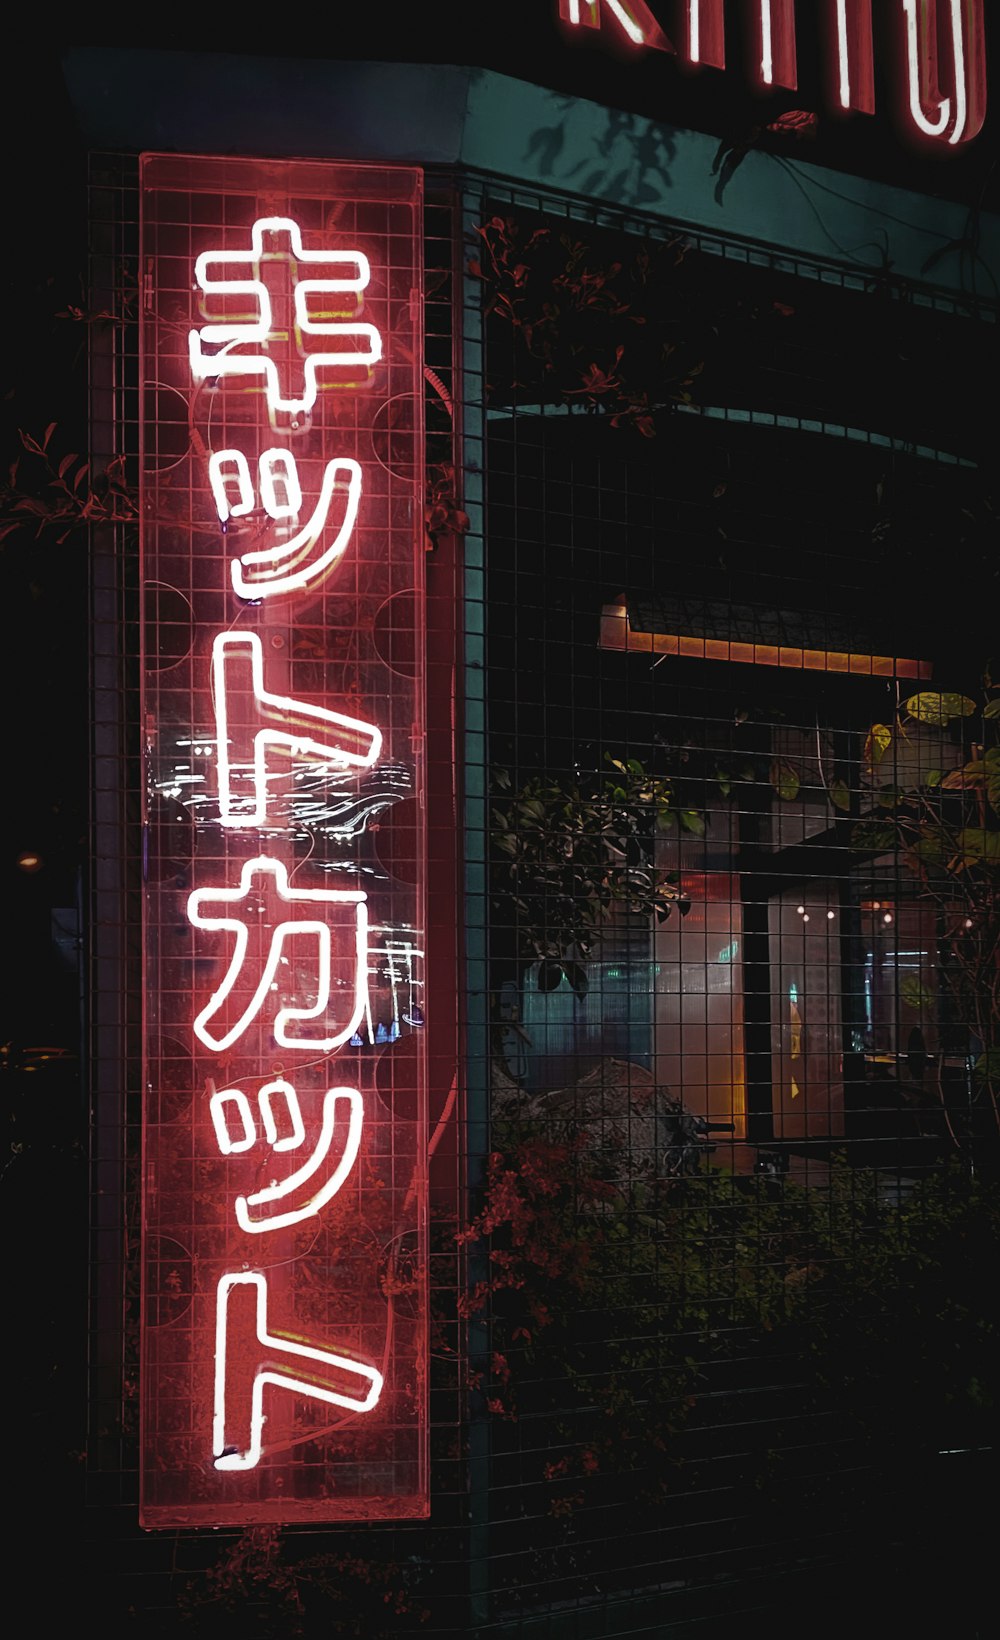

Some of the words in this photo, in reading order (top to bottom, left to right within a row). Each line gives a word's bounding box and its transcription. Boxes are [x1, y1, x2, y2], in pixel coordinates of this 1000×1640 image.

[189, 216, 383, 1471] キットカット
